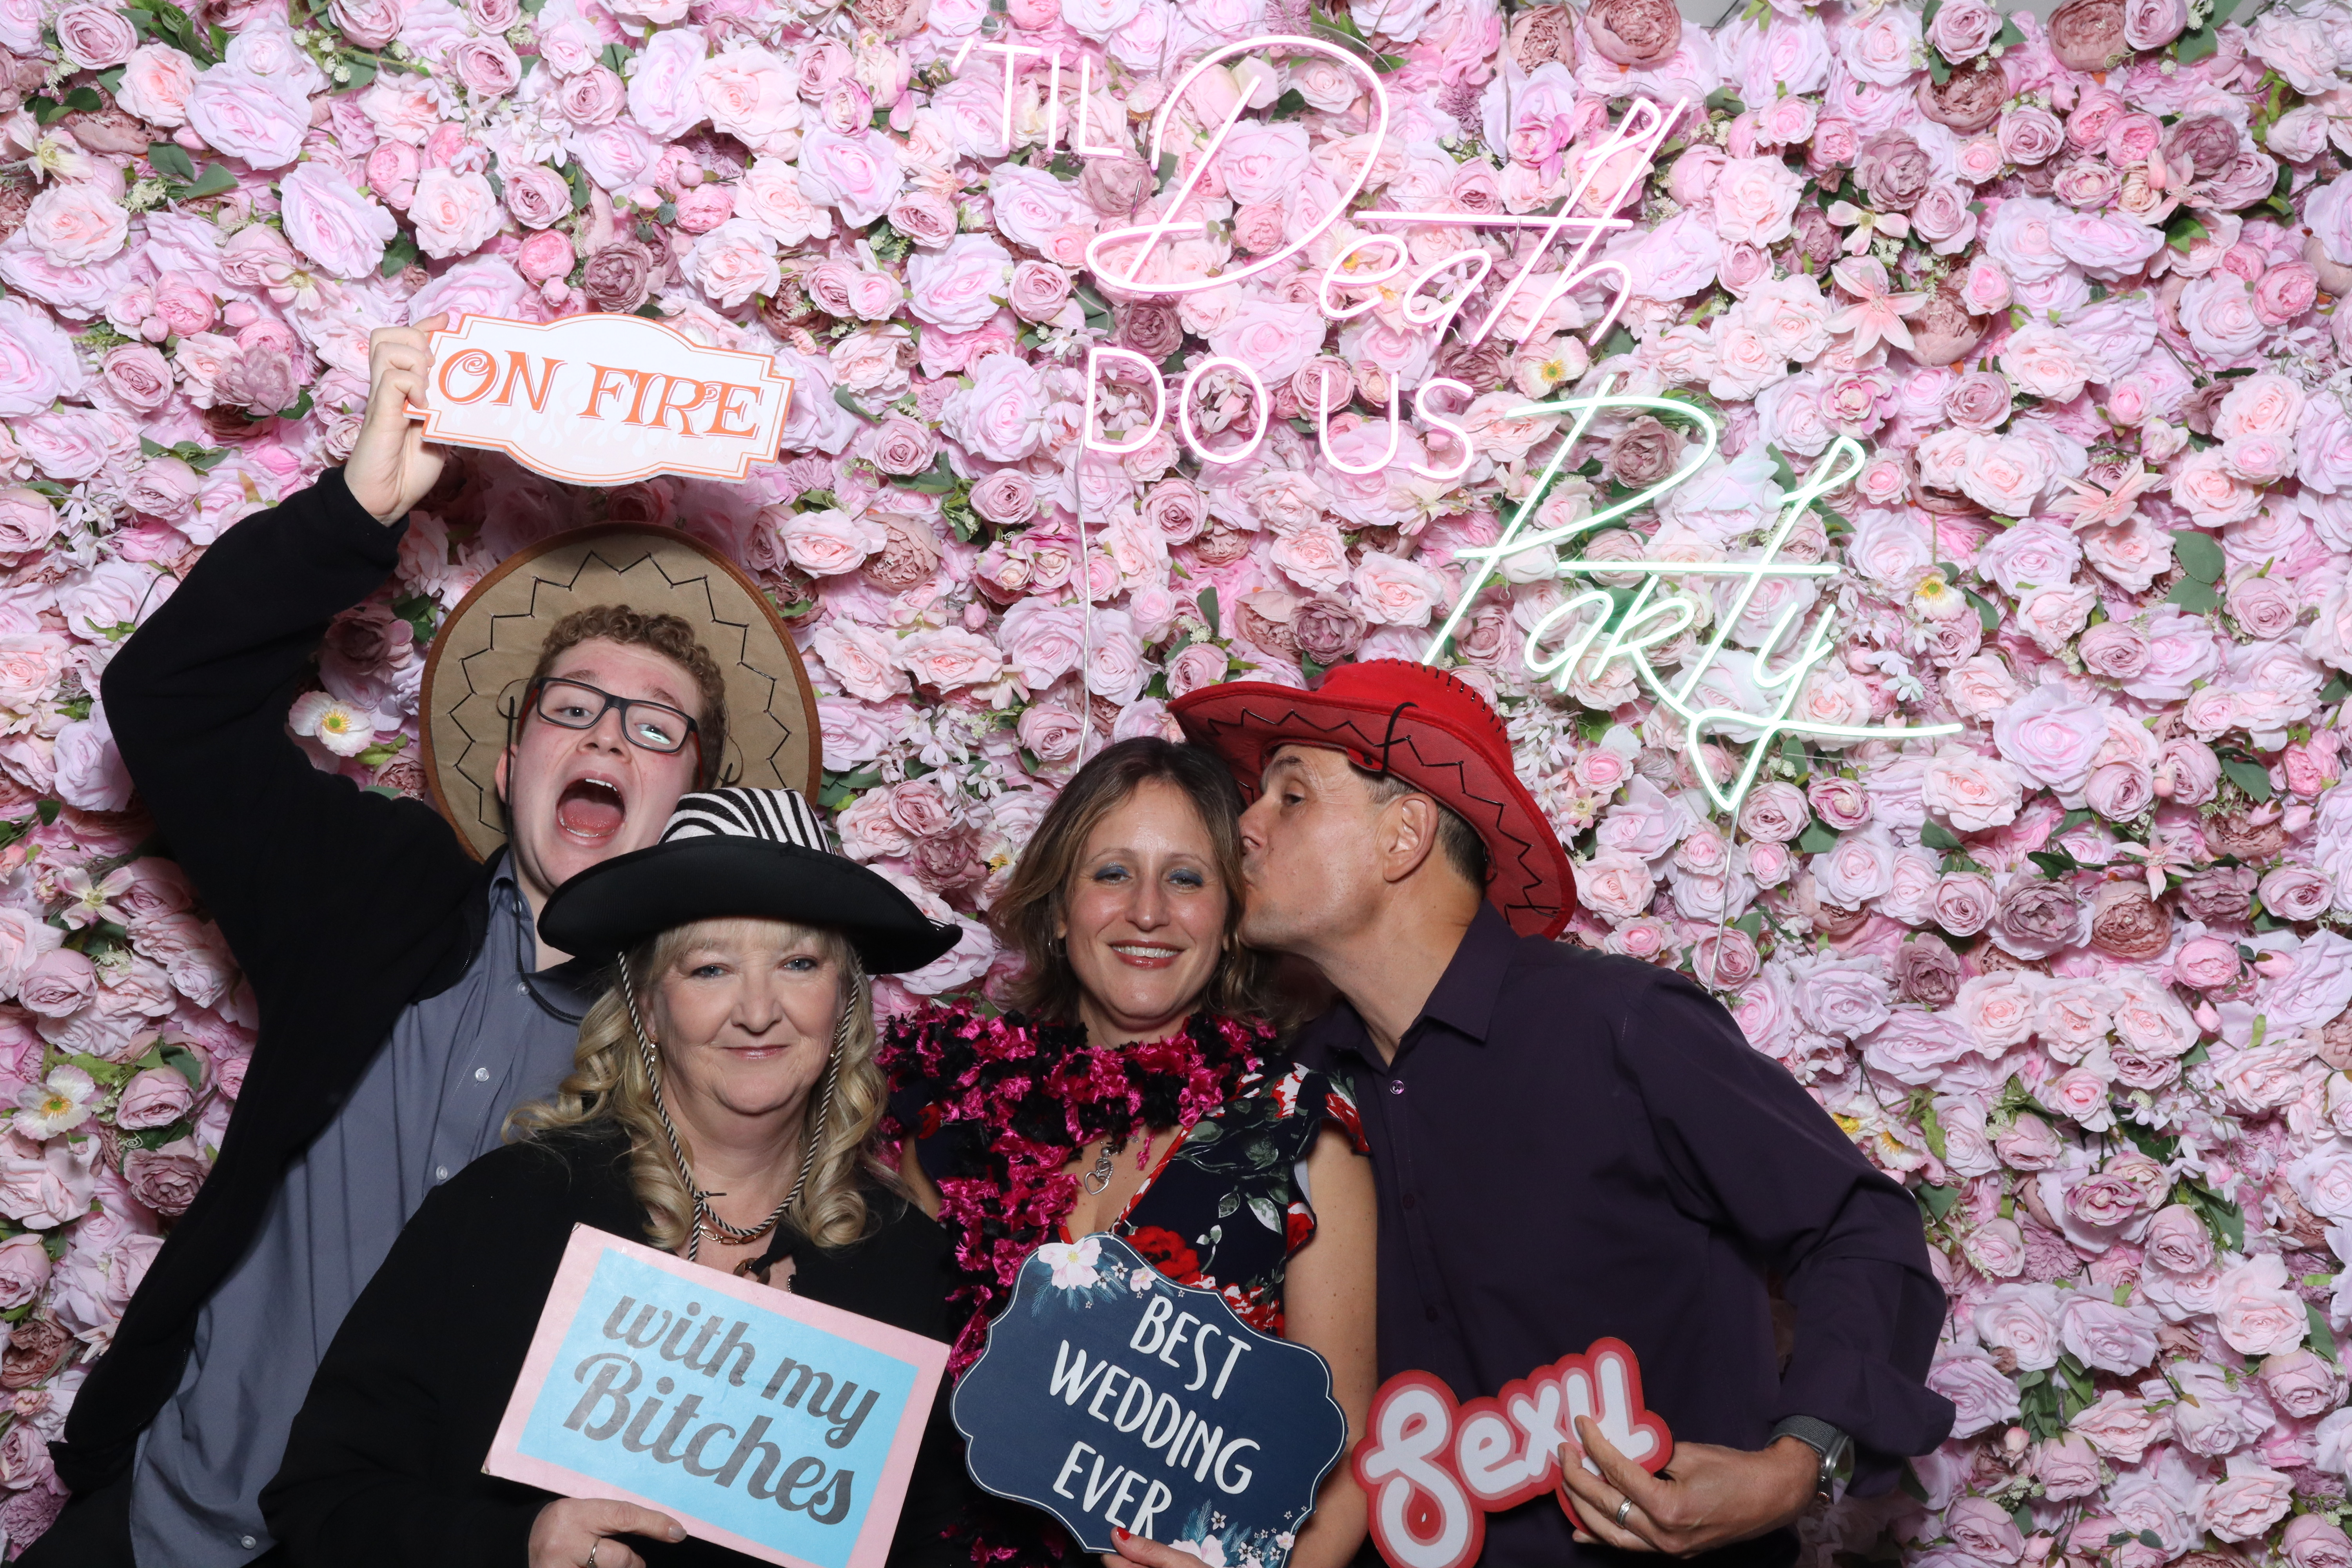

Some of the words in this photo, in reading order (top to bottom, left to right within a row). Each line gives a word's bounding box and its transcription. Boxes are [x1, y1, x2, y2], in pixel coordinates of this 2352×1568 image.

[1085, 34, 1689, 347] Death
[437, 348, 565, 414] ON
[577, 362, 764, 439] FIRE
[1084, 347, 1269, 465] DO
[1318, 368, 1475, 480] US
[602, 1295, 756, 1387] with
[760, 1357, 880, 1449] my
[1049, 1339, 1260, 1494] WEDDING
[1130, 1296, 1252, 1400] BEST
[562, 1352, 855, 1525] Bitches
[1053, 1440, 1172, 1540] EVER
[1365, 1357, 1654, 1568] Sexy
